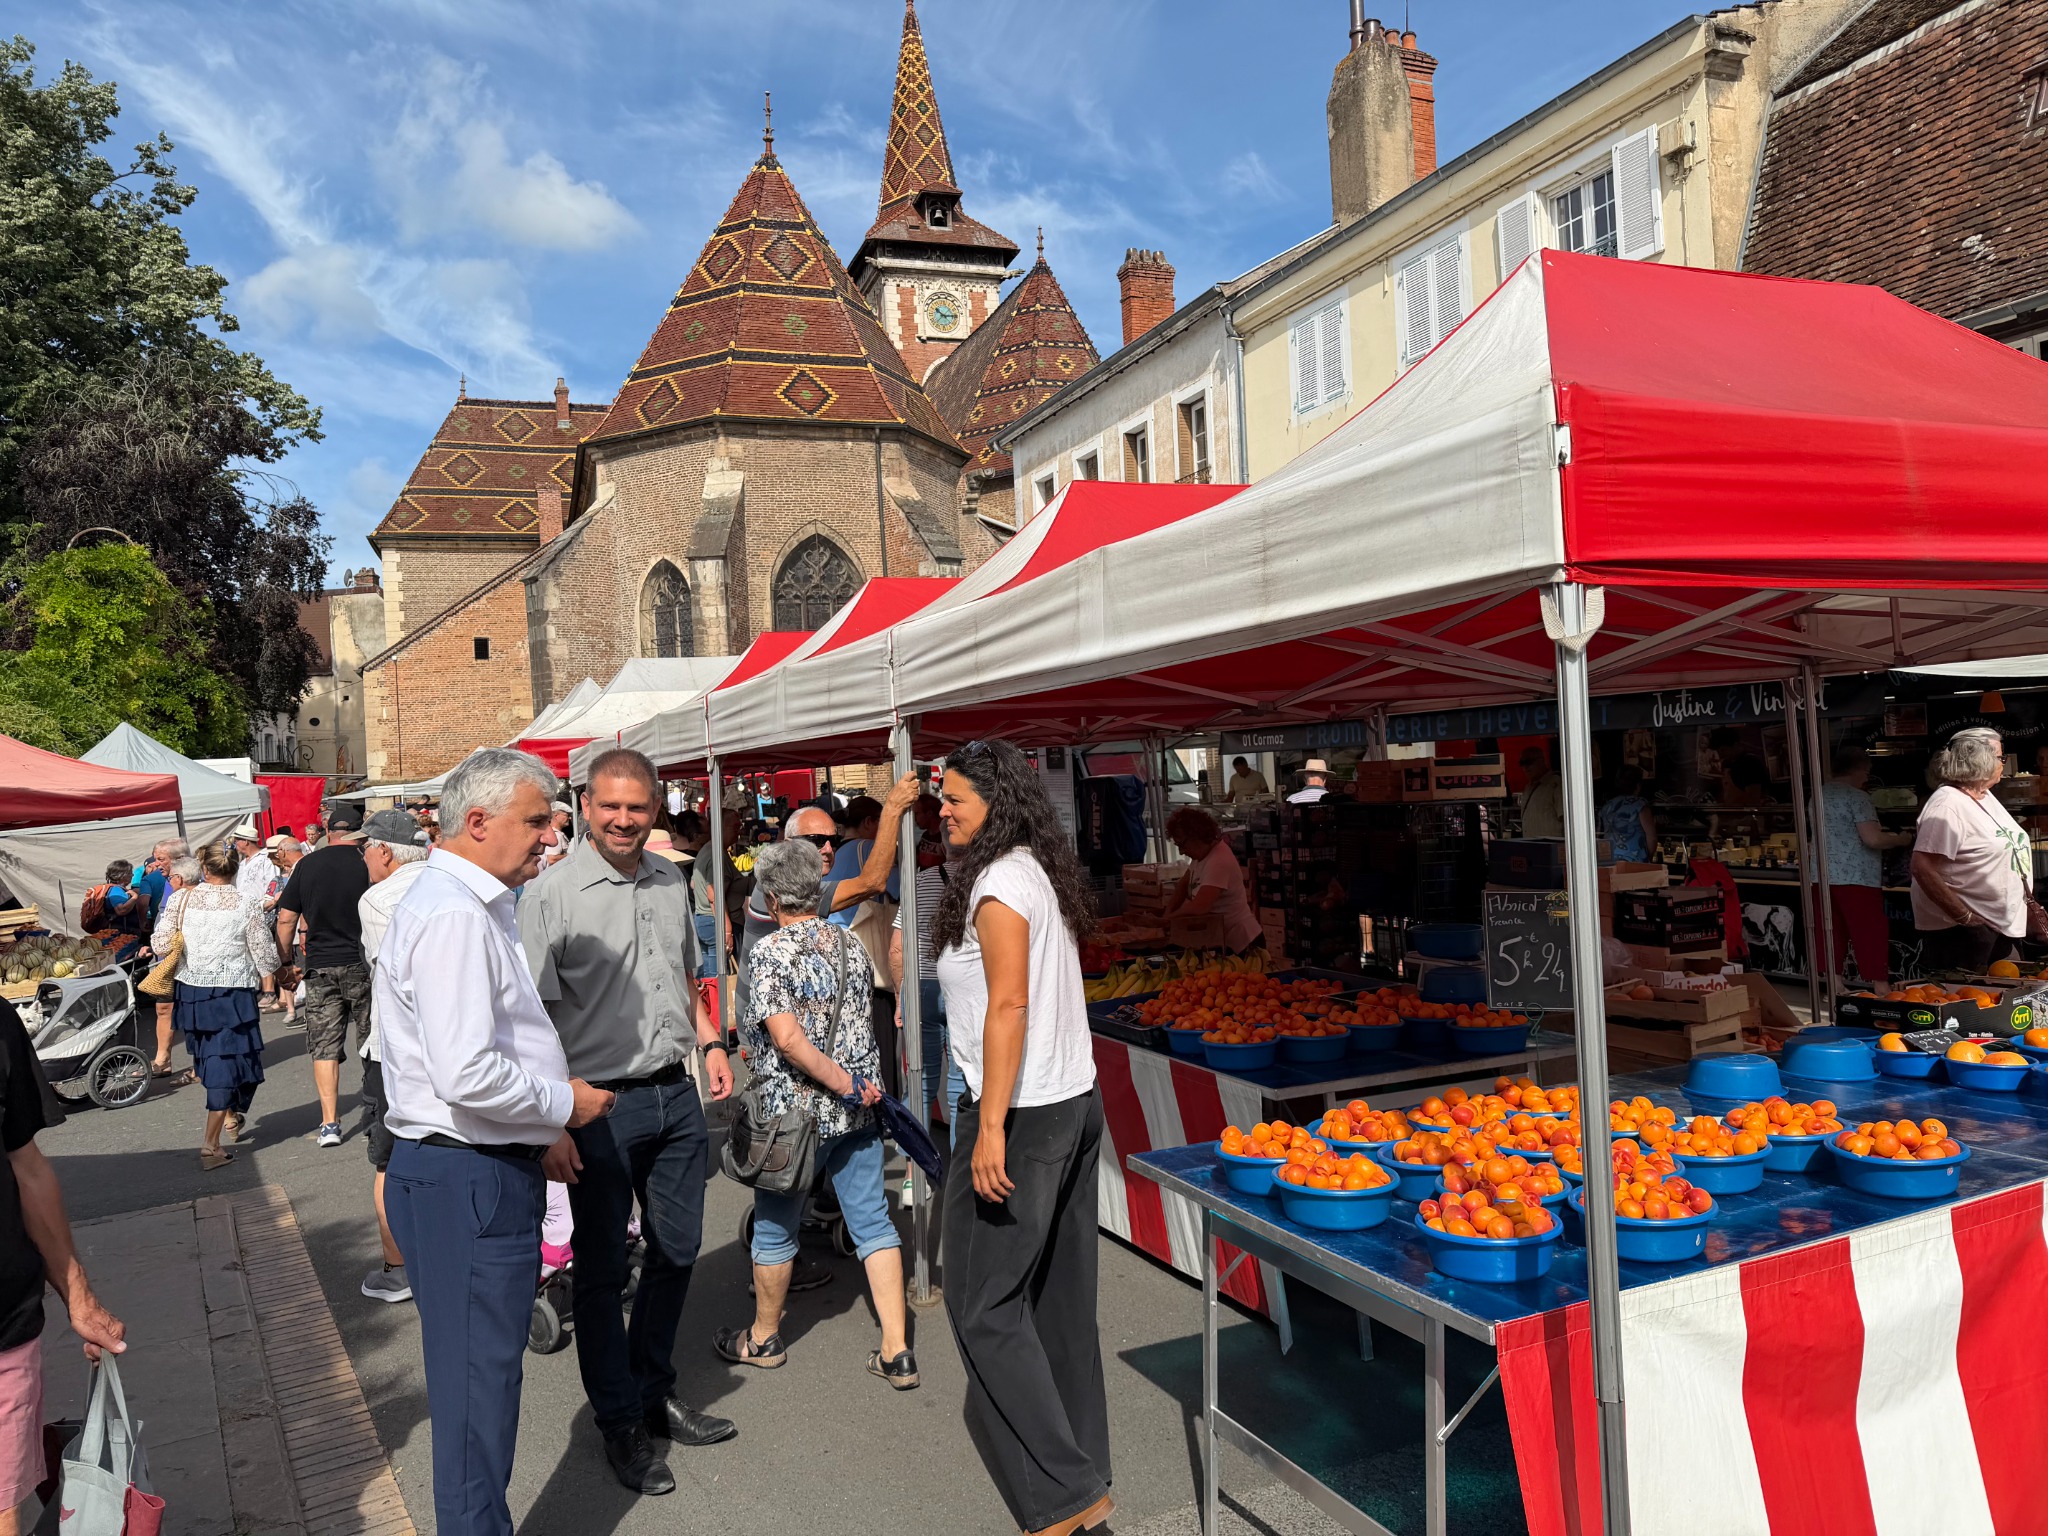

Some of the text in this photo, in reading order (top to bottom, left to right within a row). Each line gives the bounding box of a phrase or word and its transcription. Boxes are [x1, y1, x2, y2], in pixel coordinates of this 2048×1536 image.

[1652, 678, 1831, 727] Justine & Vinet
[1970, 716, 1993, 727] votre
[1994, 724, 2040, 737] disposition
[1242, 732, 1284, 747] 01 Cormoz
[1489, 915, 1525, 927] France
